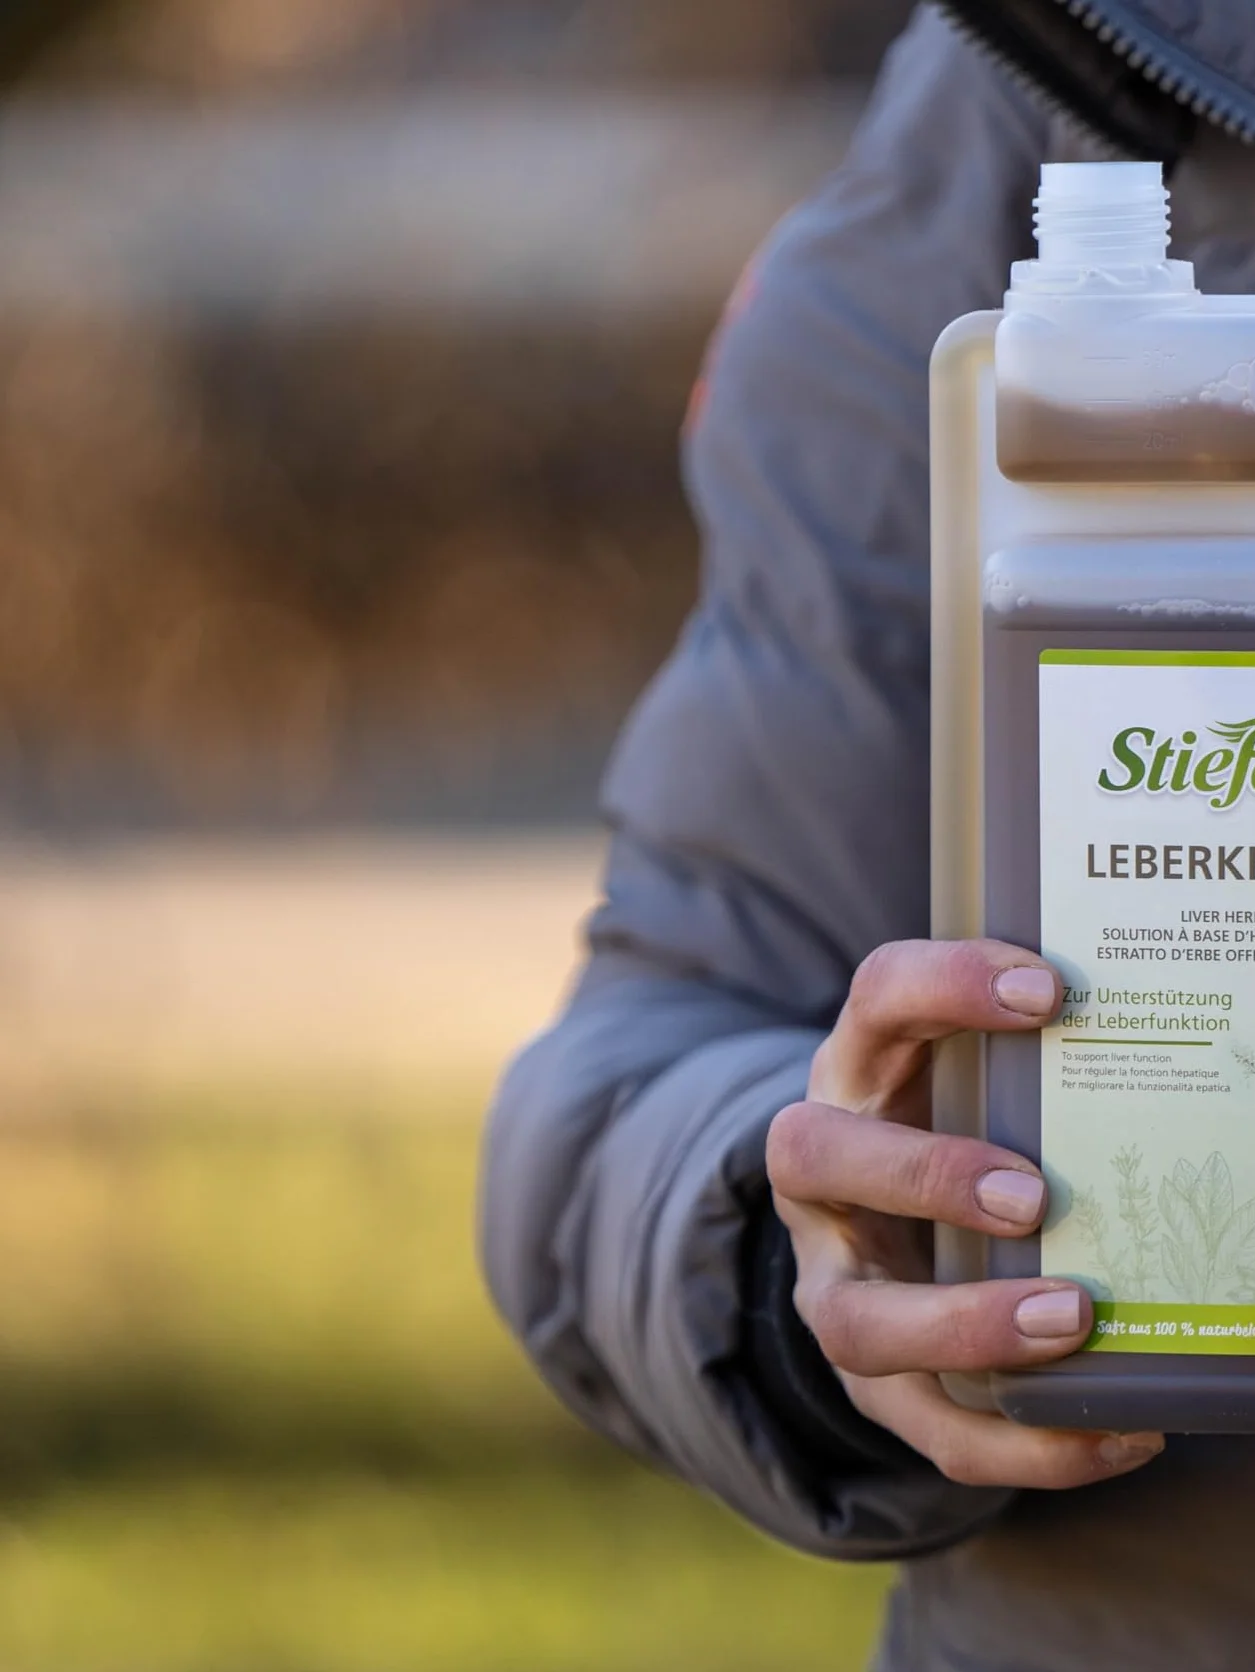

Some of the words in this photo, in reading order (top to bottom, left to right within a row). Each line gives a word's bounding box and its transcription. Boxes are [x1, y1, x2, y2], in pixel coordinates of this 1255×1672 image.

[1180, 909, 1221, 924] LIVER
[1102, 927, 1175, 943] SOLUTION
[1177, 926, 1190, 943] À
[1193, 929, 1231, 944] BASE
[1096, 946, 1168, 961] ESTRATTO
[1062, 986, 1092, 1003] Zur
[1097, 987, 1233, 1011] Unterstützung
[1062, 1011, 1092, 1028] der
[1097, 1012, 1231, 1032] Leberfunktion
[1062, 1051, 1072, 1061] To
[1074, 1052, 1109, 1064] support
[1110, 1052, 1131, 1063] liver
[1132, 1053, 1173, 1064] function
[1061, 1066, 1082, 1075] Pour
[1084, 1066, 1118, 1078] réguler
[1119, 1067, 1128, 1077] la
[1130, 1067, 1170, 1078] fonction
[1171, 1068, 1220, 1080] hépatique
[1061, 1080, 1076, 1089] Per
[1078, 1081, 1125, 1092] migliorare
[1126, 1081, 1135, 1091] la
[1137, 1081, 1194, 1092] funzionalità
[1196, 1083, 1232, 1094] epatica
[1097, 1319, 1127, 1336] Saft
[1128, 1322, 1151, 1335] aus
[1154, 1321, 1177, 1336] 100
[1180, 1322, 1195, 1337] %
